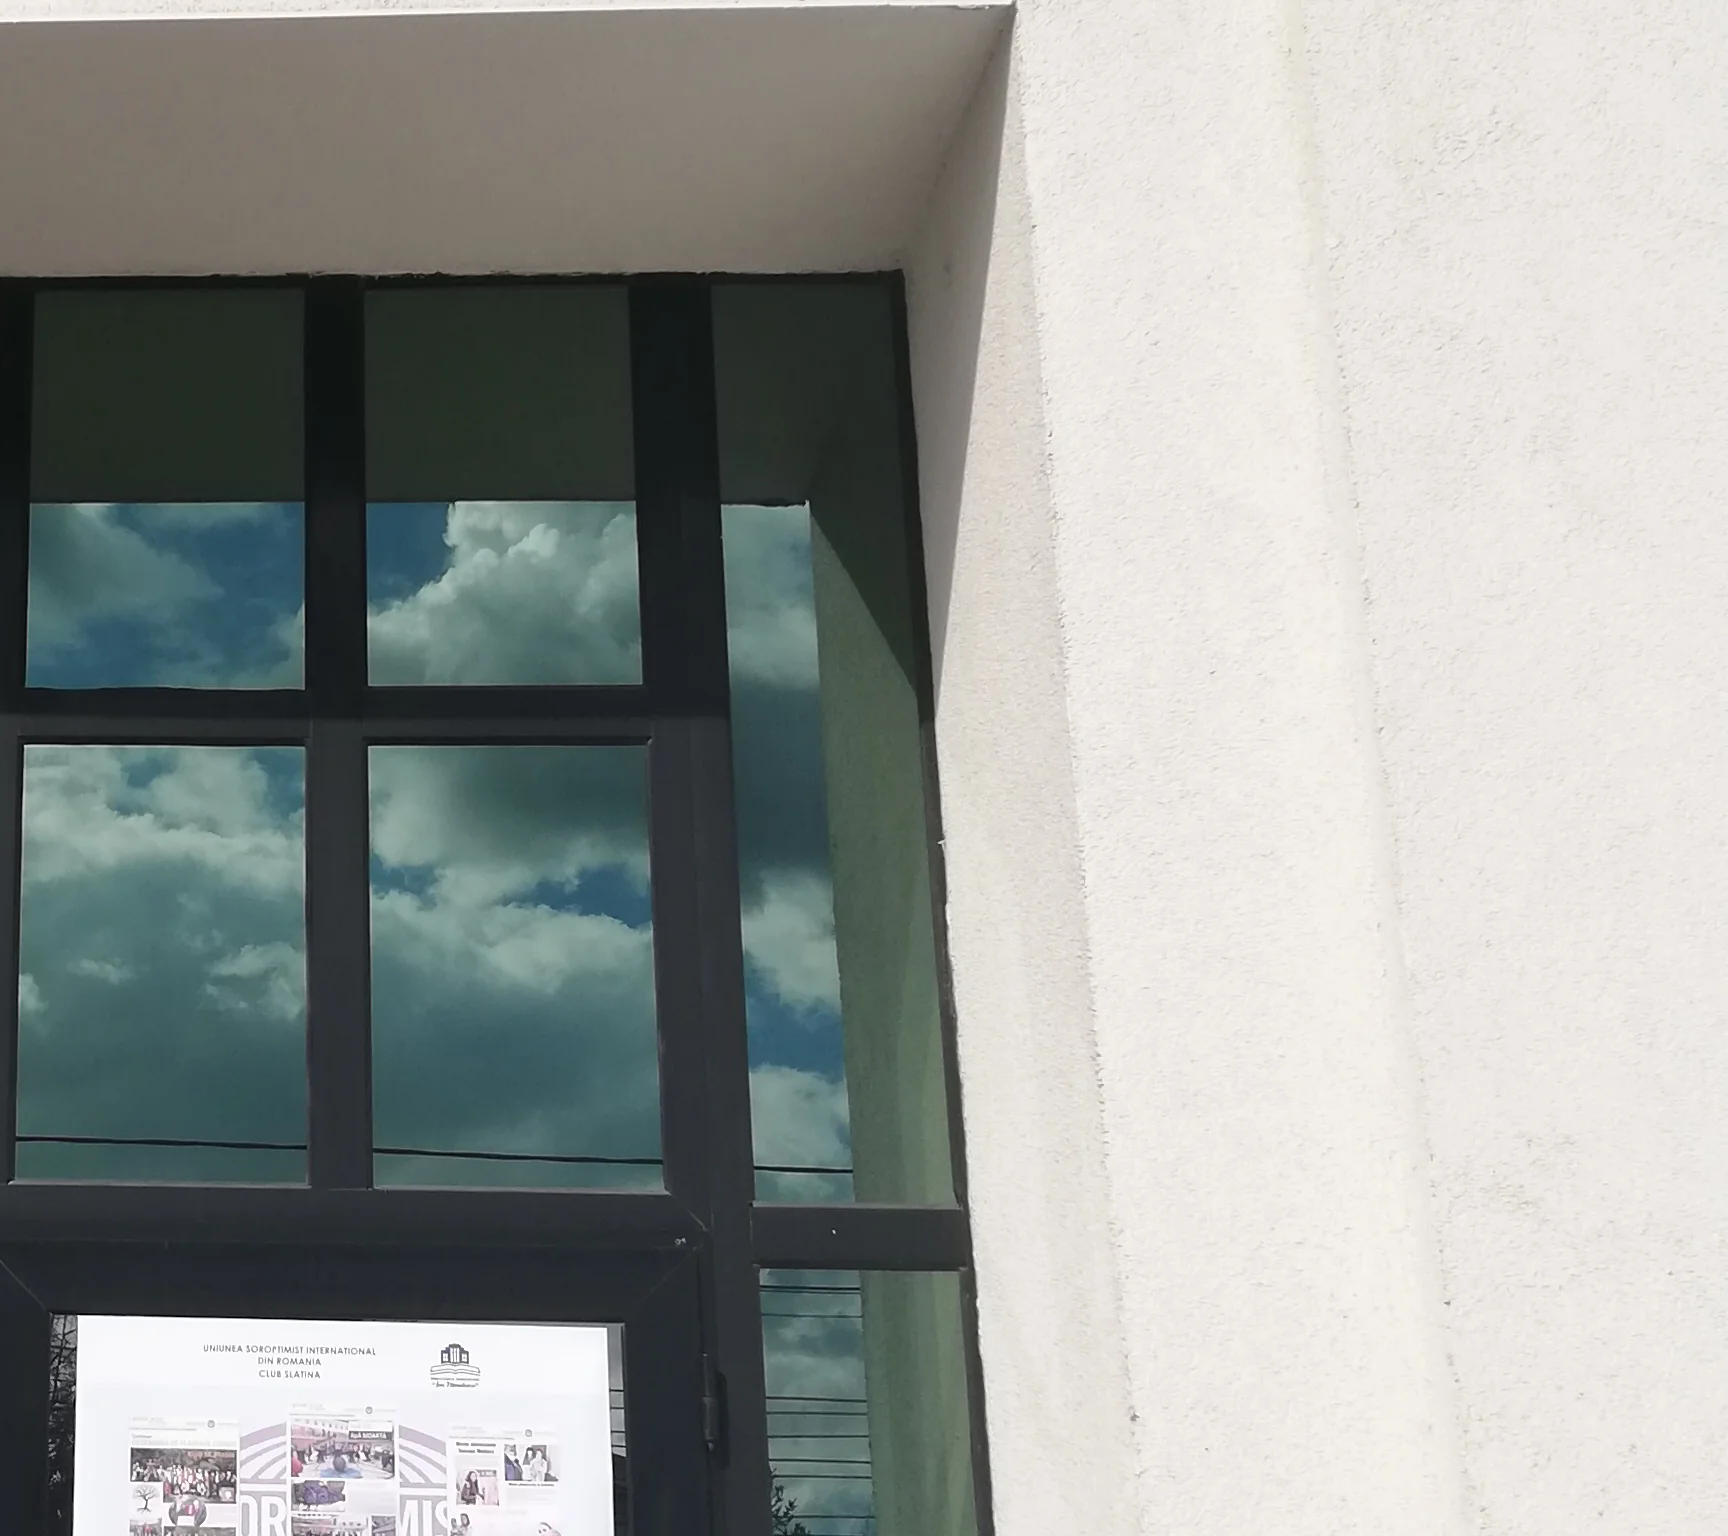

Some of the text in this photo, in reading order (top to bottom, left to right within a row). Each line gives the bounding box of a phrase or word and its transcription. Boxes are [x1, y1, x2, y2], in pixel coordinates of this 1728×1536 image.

[203, 1345, 376, 1356] UNIUNEA SOROPTIMIST INTERNATIONAL
[258, 1357, 322, 1366] DIN ROMANIA
[259, 1370, 321, 1379] CLUB SLATINA
